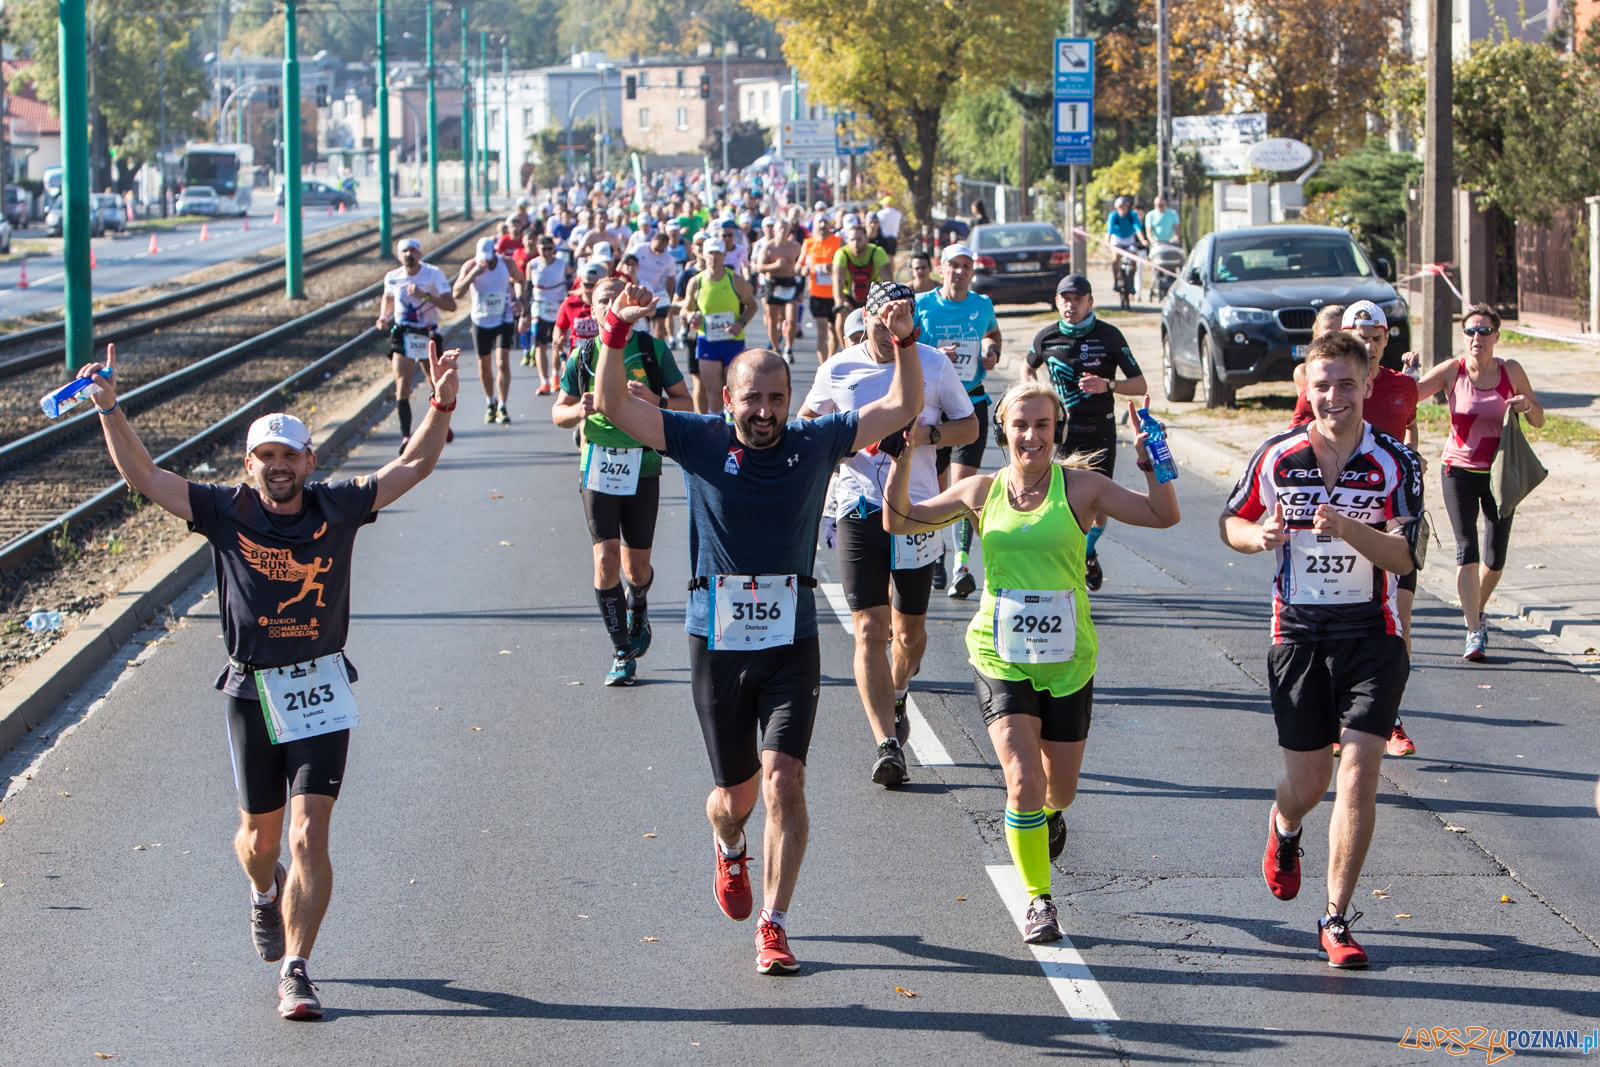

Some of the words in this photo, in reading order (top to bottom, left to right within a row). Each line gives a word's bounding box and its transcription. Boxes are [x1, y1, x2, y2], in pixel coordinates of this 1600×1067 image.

[951, 353, 972, 366] 277
[600, 461, 631, 476] 2474
[260, 560, 287, 570] RUN
[1306, 555, 1357, 574] 2337
[269, 569, 289, 579] FLY
[732, 601, 782, 621] 3156
[270, 617, 297, 625] ZURICH
[1012, 614, 1062, 634] 2962
[281, 630, 319, 638] BARCELONA
[283, 683, 335, 712] 2163
